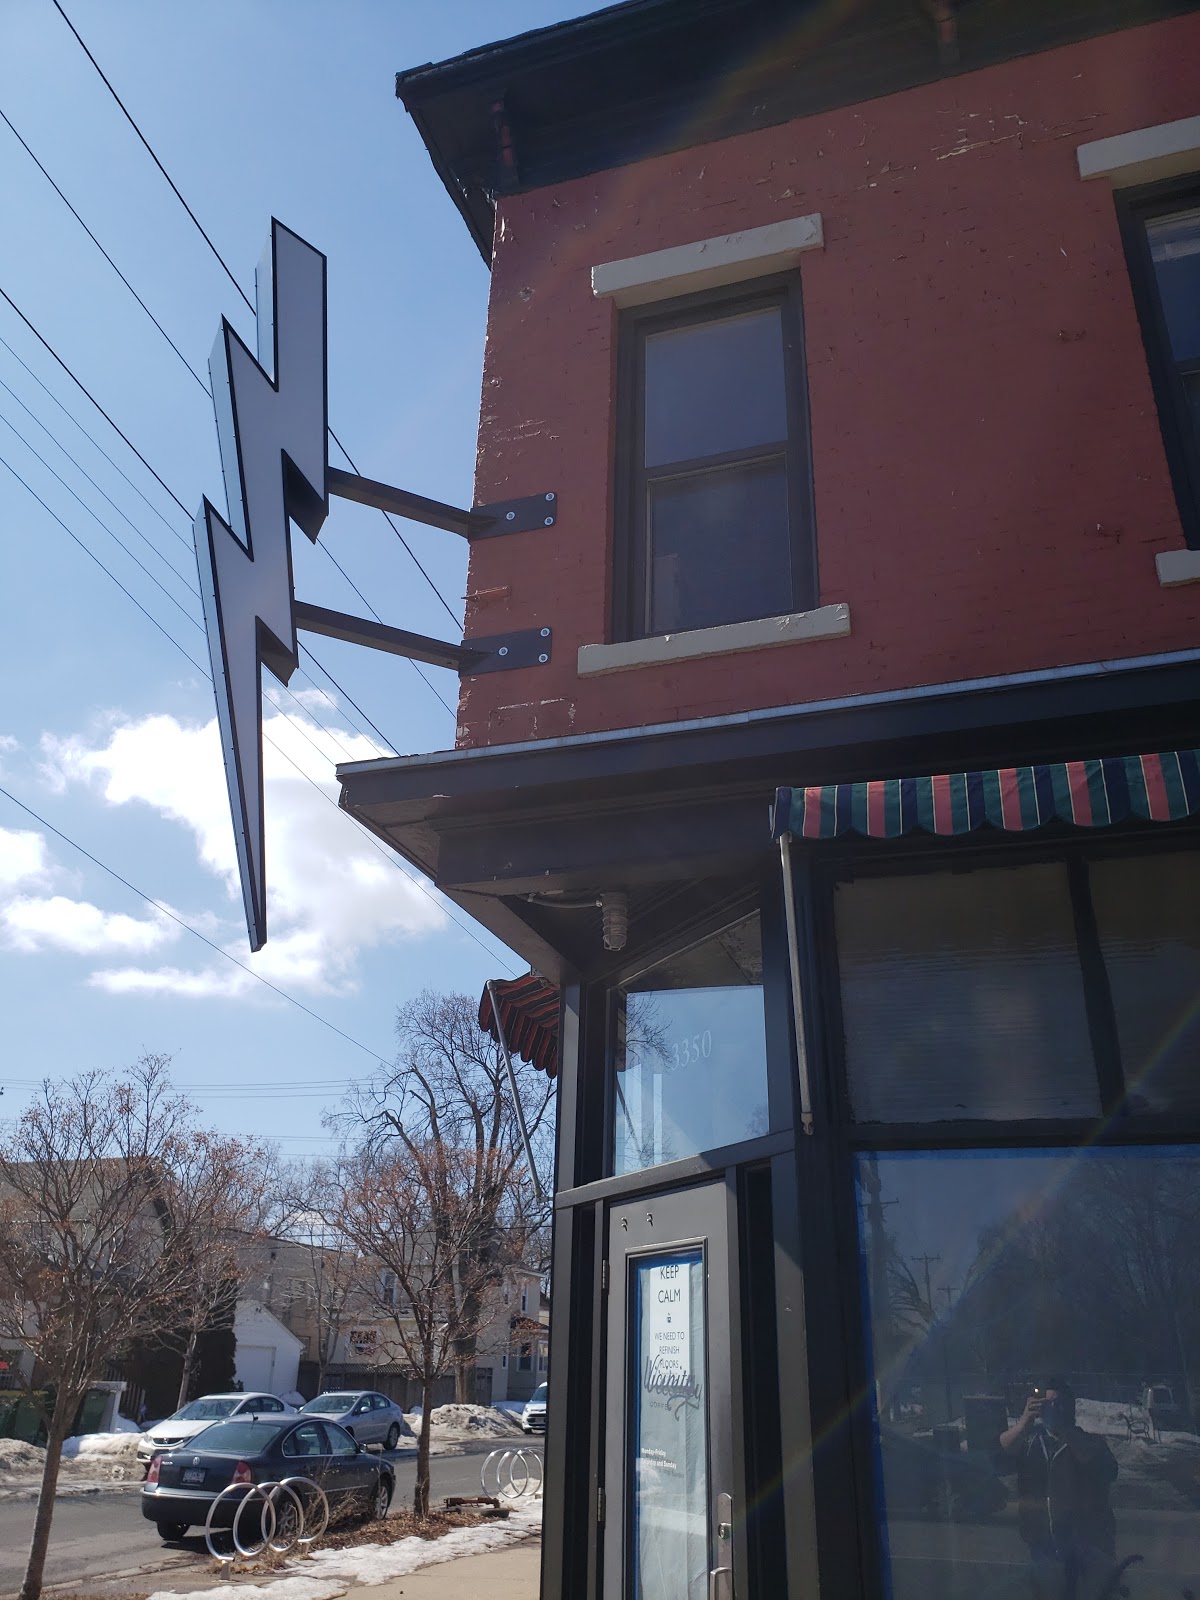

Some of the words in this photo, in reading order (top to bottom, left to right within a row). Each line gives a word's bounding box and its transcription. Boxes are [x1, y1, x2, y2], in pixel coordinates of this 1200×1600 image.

[671, 1029, 712, 1071] 3350
[660, 1264, 680, 1280] KEEP
[658, 1288, 681, 1304] CALM
[654, 1332, 663, 1341] WE
[663, 1331, 677, 1341] NEED
[677, 1331, 685, 1341] TO
[659, 1345, 680, 1355] REFINISH
